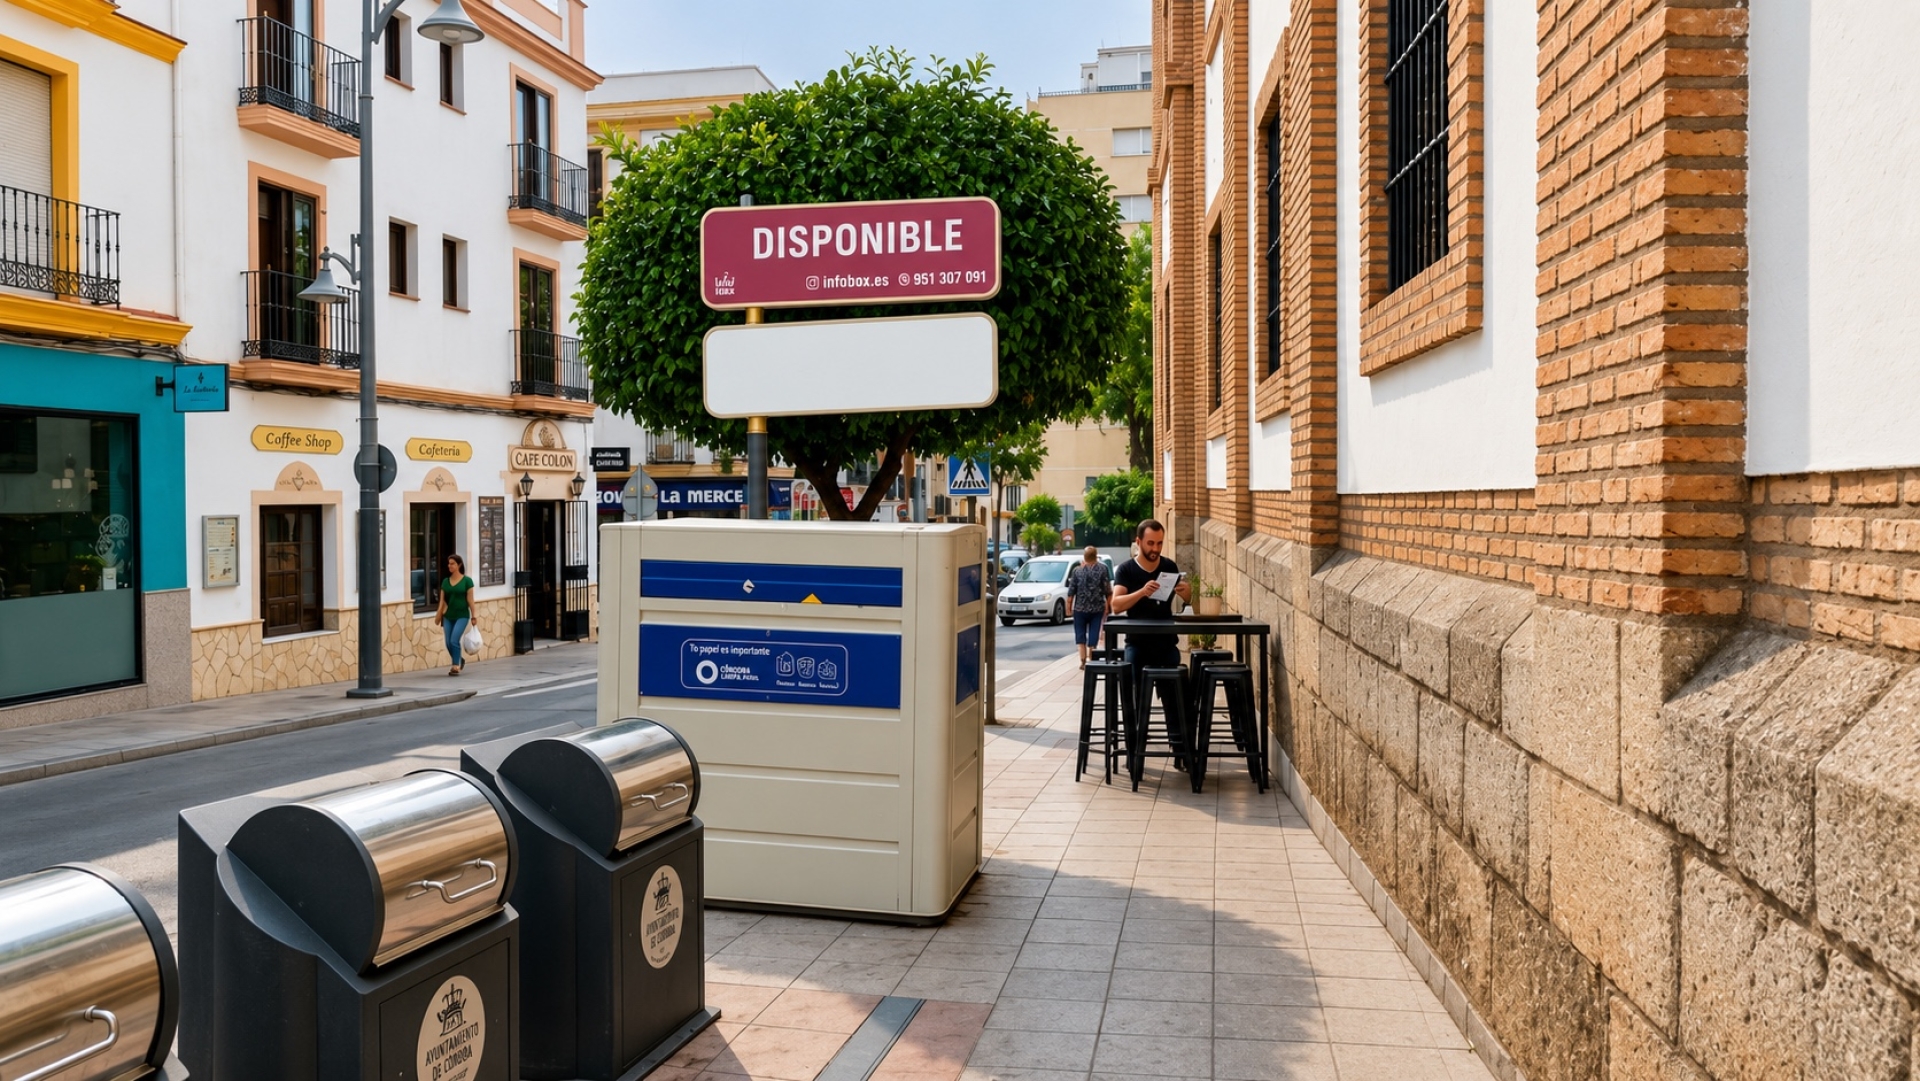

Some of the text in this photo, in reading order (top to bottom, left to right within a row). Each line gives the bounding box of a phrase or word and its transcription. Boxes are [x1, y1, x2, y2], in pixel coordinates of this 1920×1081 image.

[753, 218, 963, 260] DISPONIBLE
[823, 270, 987, 289] infobox.es 951 307 091
[265, 432, 332, 452] Coffee Shop
[515, 452, 574, 468] CAFE COLON
[660, 490, 681, 503] La
[687, 489, 743, 503] MERCE
